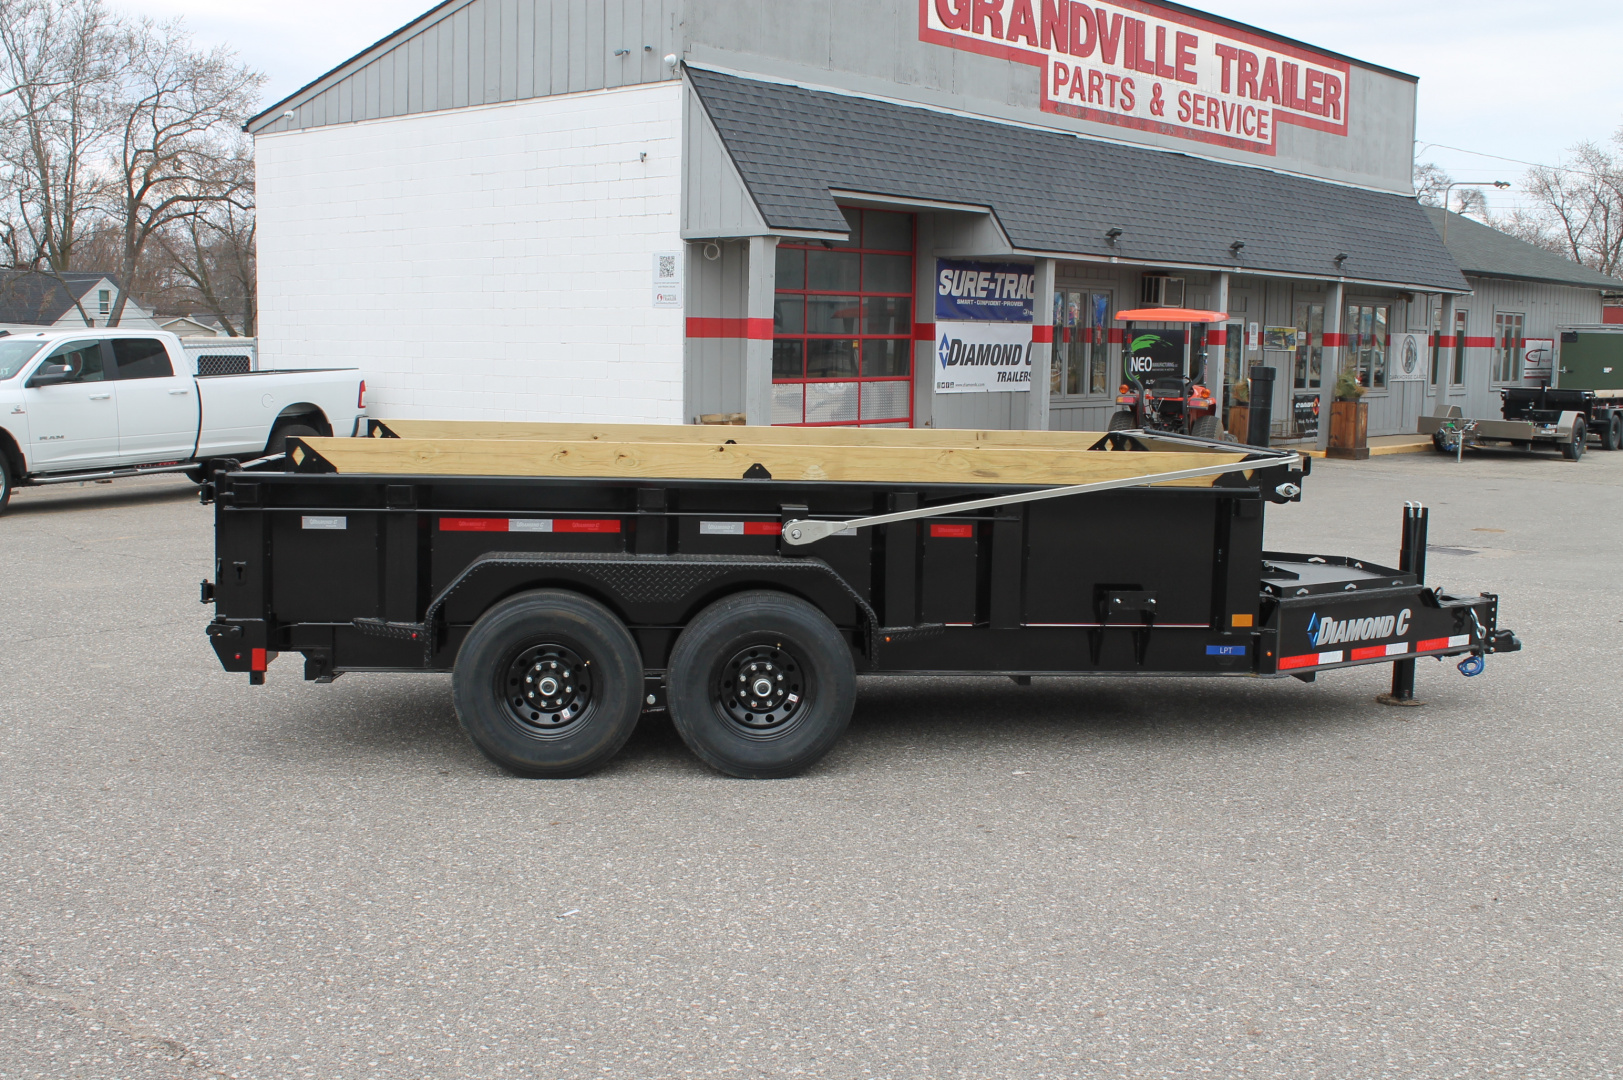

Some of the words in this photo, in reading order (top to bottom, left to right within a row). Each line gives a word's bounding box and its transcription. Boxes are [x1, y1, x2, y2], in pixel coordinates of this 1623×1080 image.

[934, 0, 1198, 85] GRANDVILLE
[1215, 43, 1341, 120] TRAILER
[1054, 62, 1135, 111] PARTS
[1150, 83, 1165, 116] &
[1177, 90, 1269, 140] SERVICE
[947, 339, 1022, 366] DIAMOND
[1131, 356, 1152, 372] NEO
[1316, 615, 1396, 646] DIAMOND
[1395, 608, 1411, 636] C
